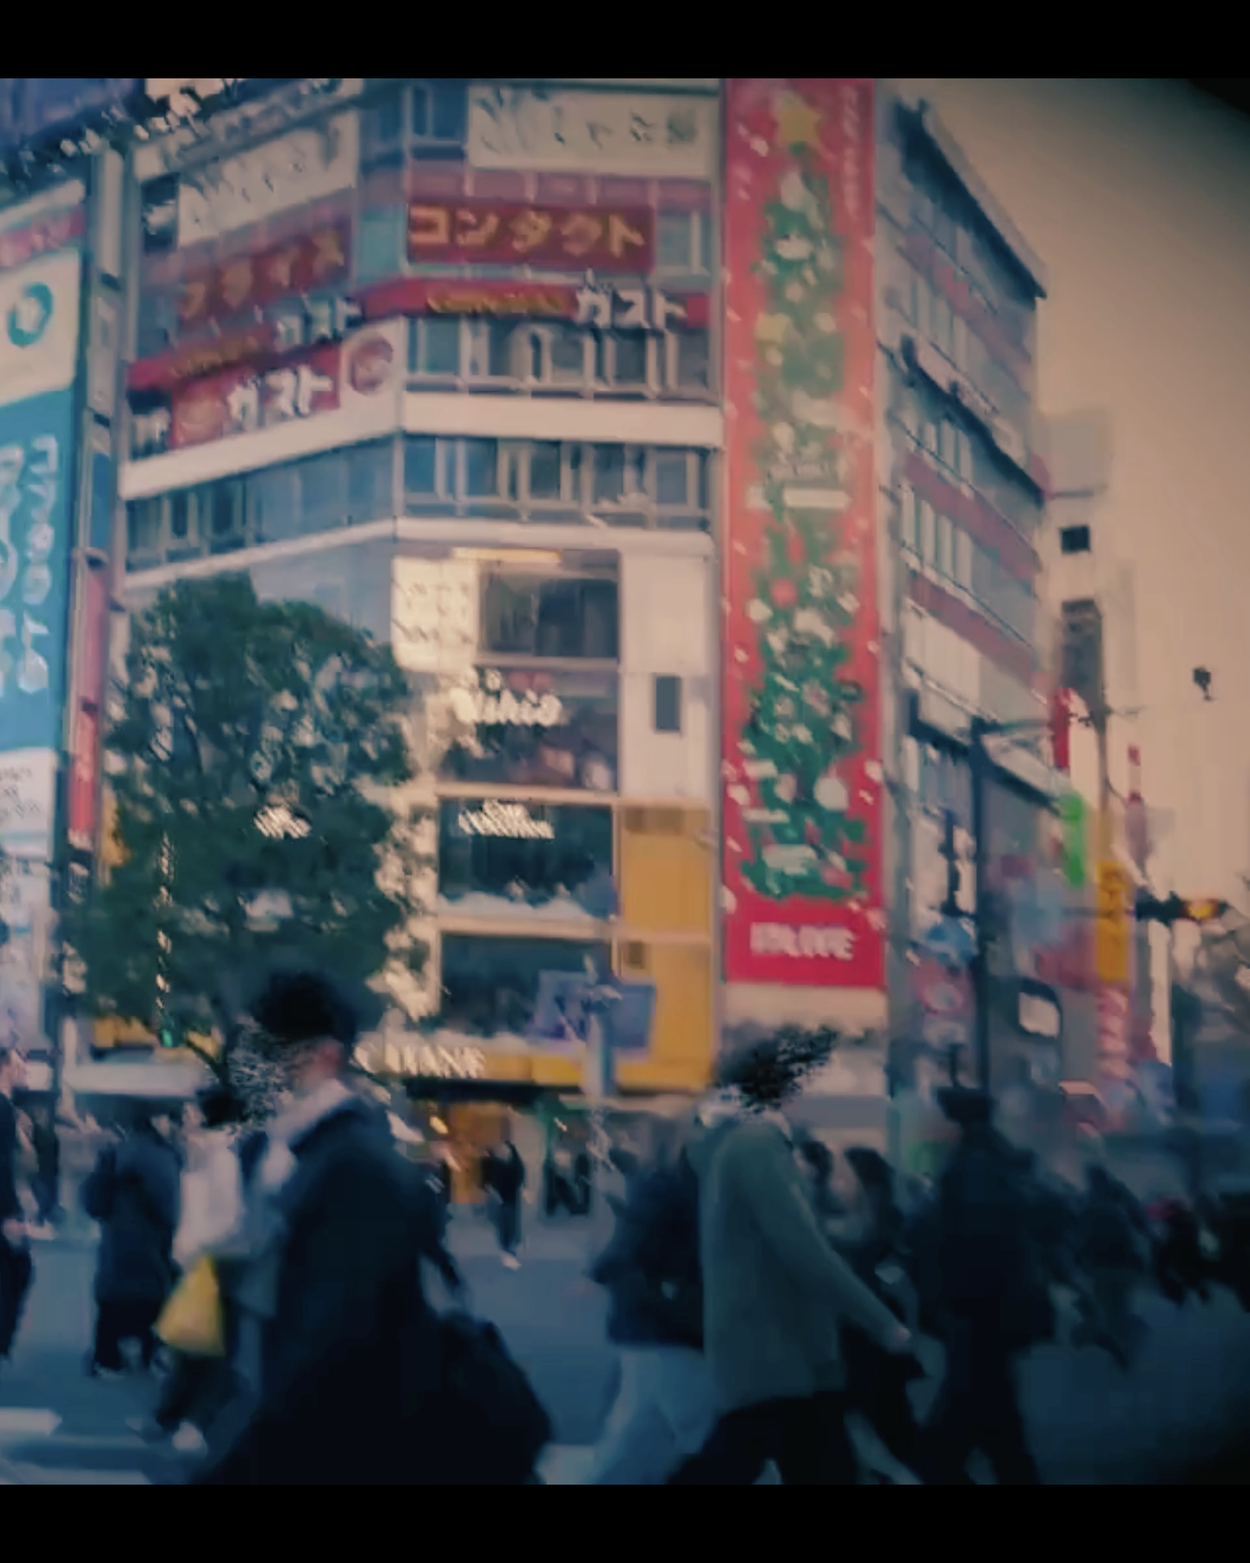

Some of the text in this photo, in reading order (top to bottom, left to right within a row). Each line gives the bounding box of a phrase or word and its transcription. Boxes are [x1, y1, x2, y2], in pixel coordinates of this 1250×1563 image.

[408, 203, 646, 258] コンタクト
